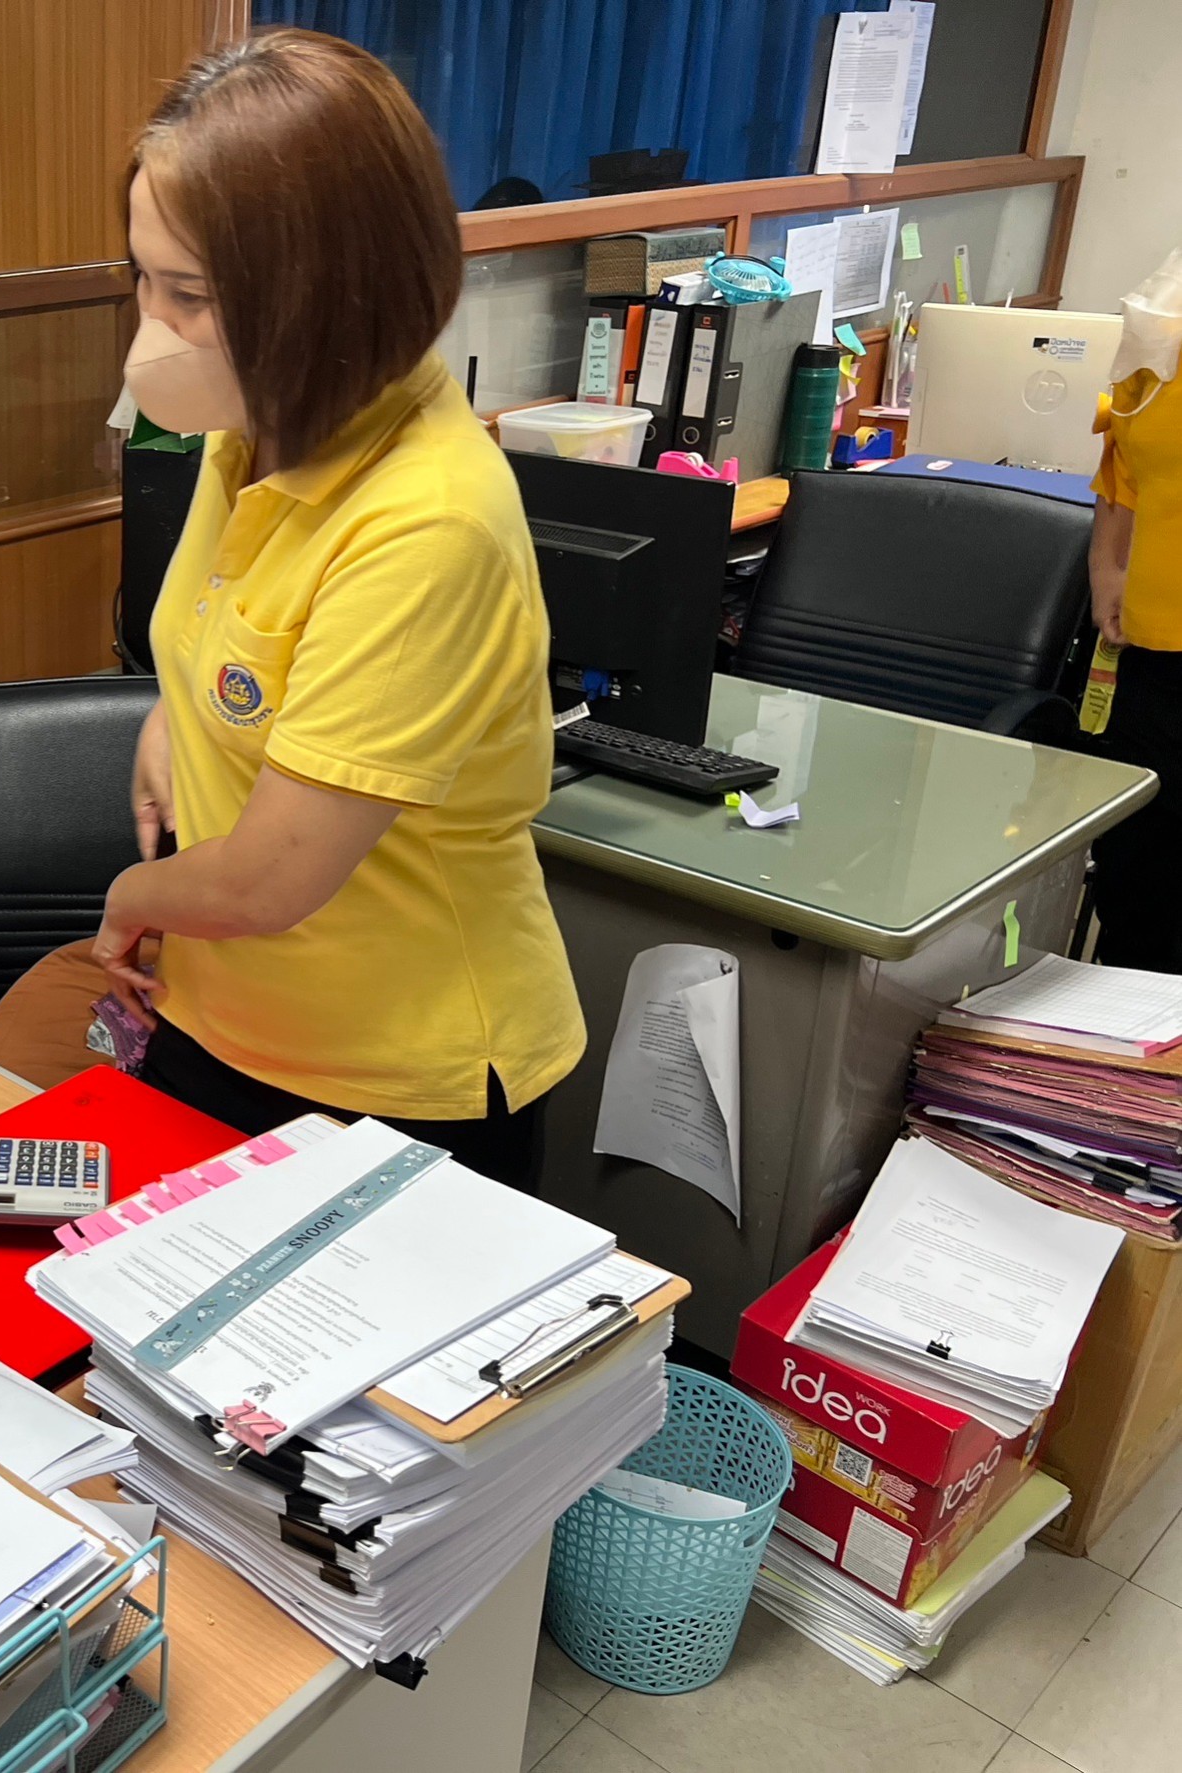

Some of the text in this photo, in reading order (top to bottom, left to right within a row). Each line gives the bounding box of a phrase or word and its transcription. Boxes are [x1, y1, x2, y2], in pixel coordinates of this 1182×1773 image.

[255, 1209, 346, 1273] PEANUTS SNOOPY
[780, 1356, 888, 1446] idea
[852, 1391, 894, 1418] WORK
[937, 1442, 1003, 1520] idea
